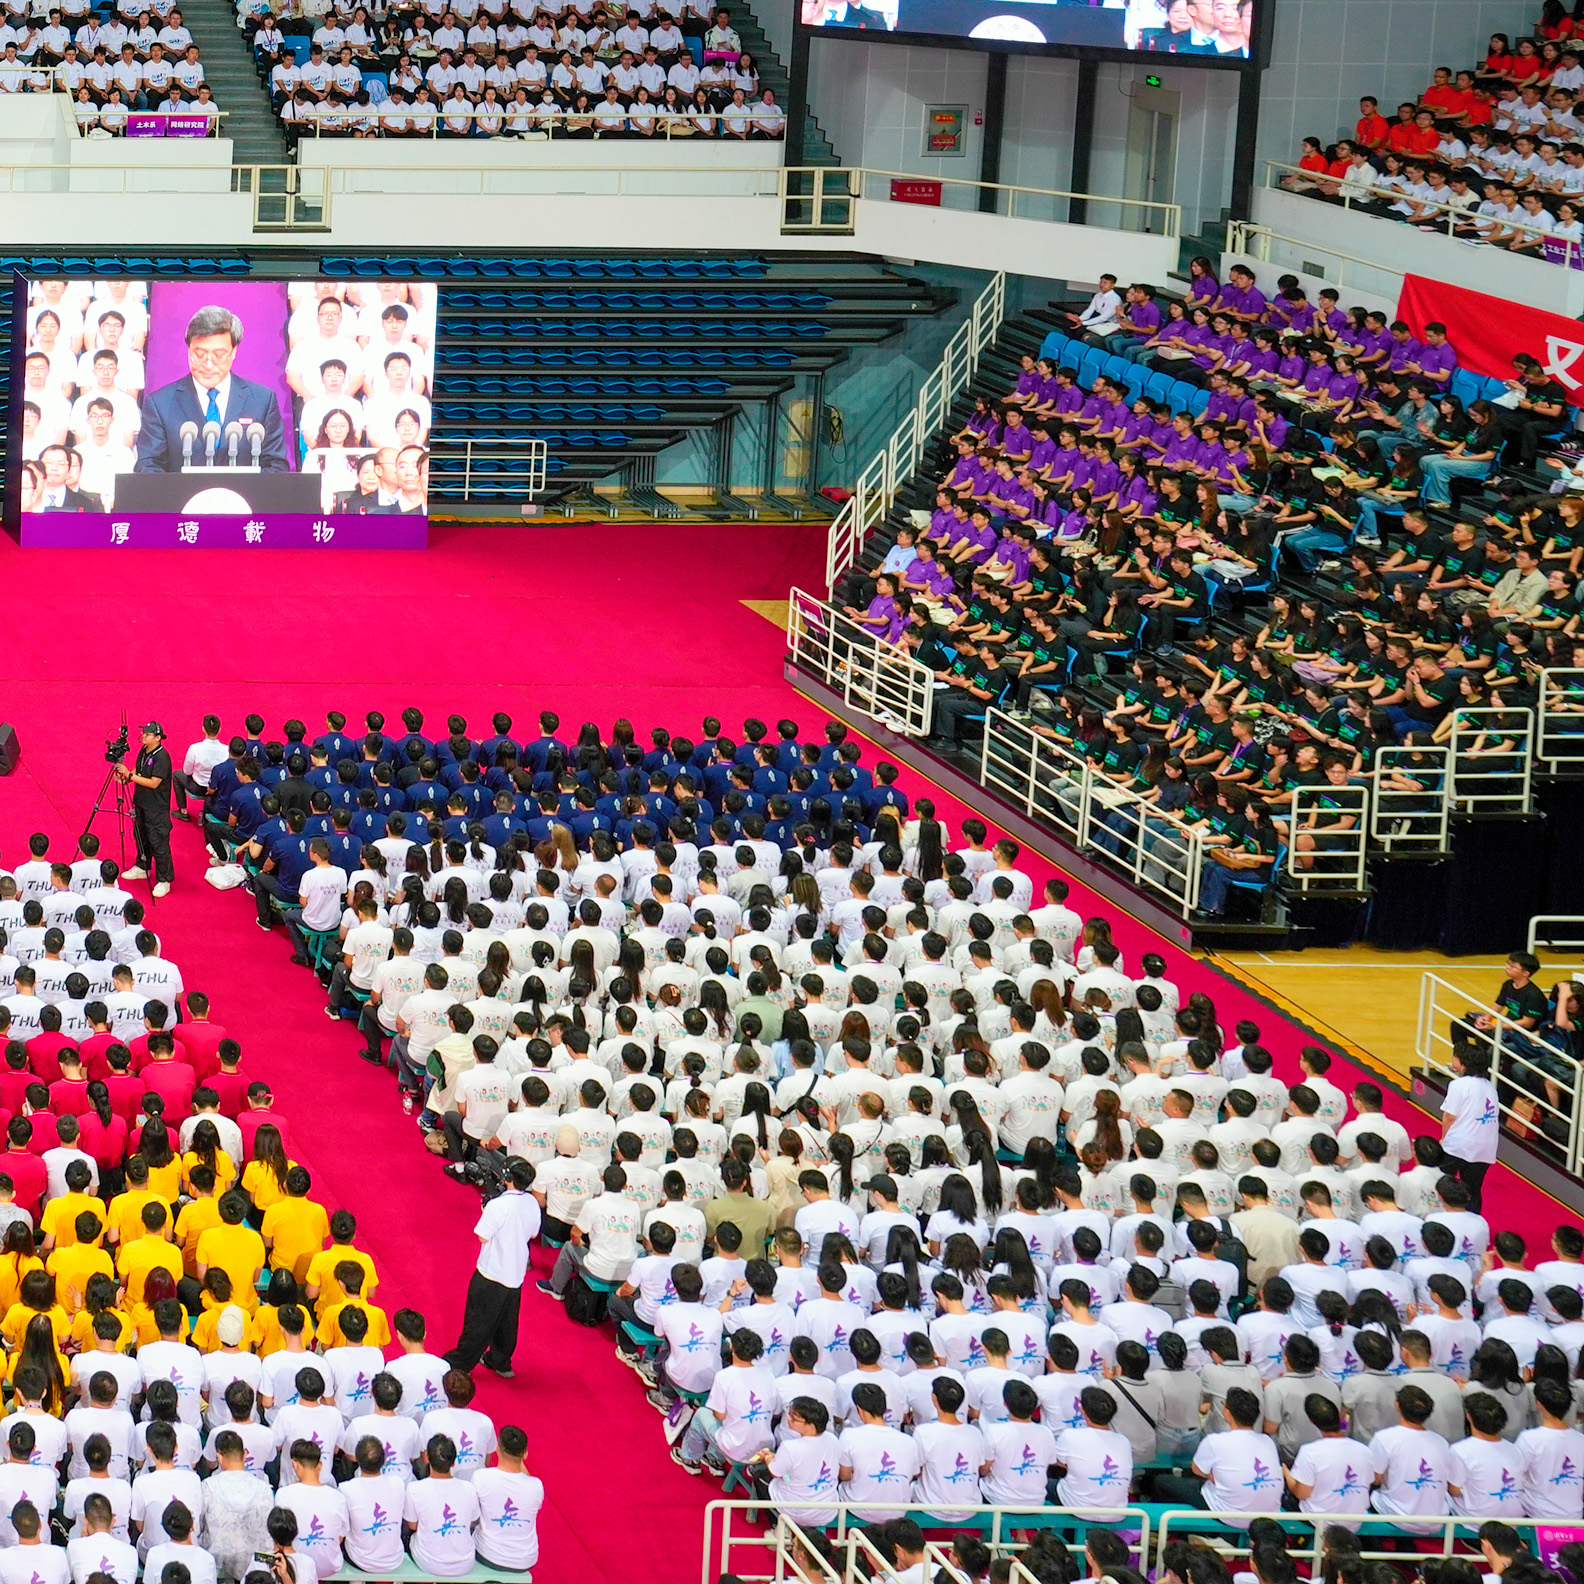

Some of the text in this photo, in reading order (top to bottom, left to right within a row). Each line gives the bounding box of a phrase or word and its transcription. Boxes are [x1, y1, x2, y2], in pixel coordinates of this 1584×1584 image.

[171, 121, 204, 129] 网络研究院
[26, 949, 44, 960] TH
[137, 973, 168, 983] THU
